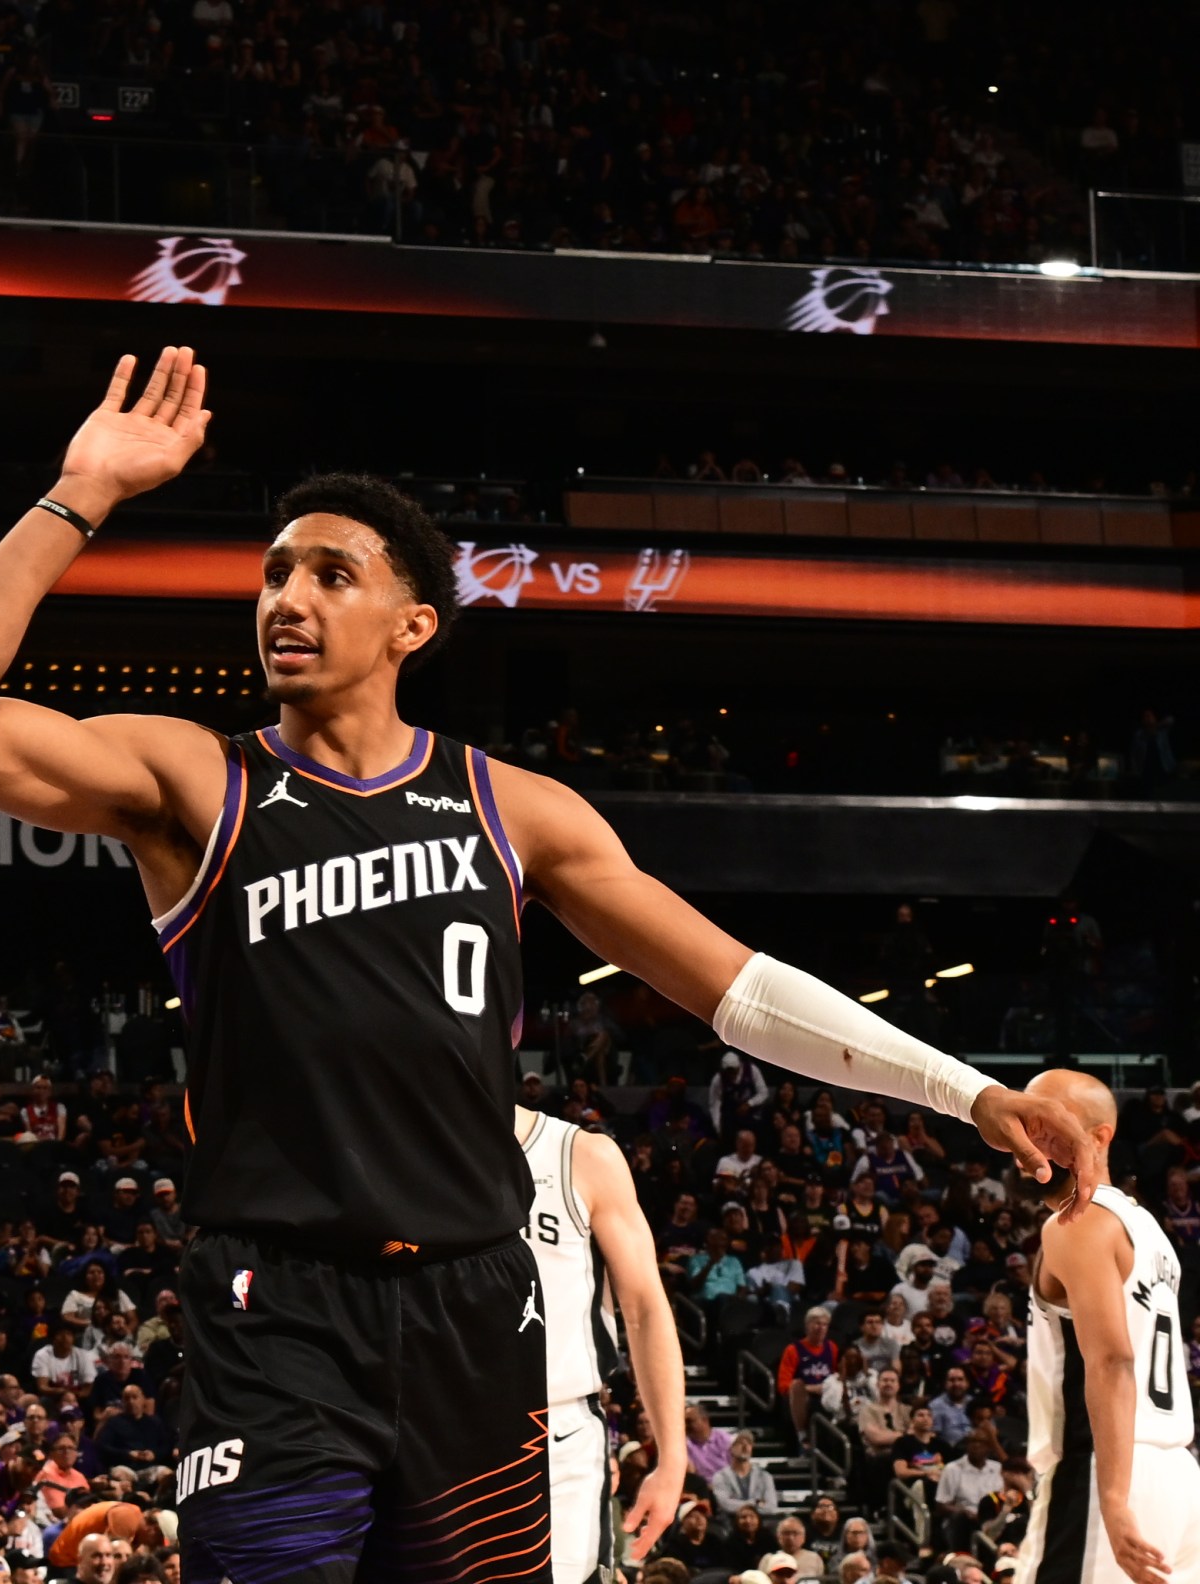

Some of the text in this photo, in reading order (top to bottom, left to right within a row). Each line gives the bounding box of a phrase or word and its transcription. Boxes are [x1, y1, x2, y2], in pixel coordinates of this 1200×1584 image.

[549, 561, 602, 594] VS
[405, 791, 472, 814] PayPal
[243, 834, 489, 945] PHOENIX
[442, 921, 490, 1017] 0
[1148, 1312, 1174, 1412] 0
[175, 1437, 245, 1506] UNS
